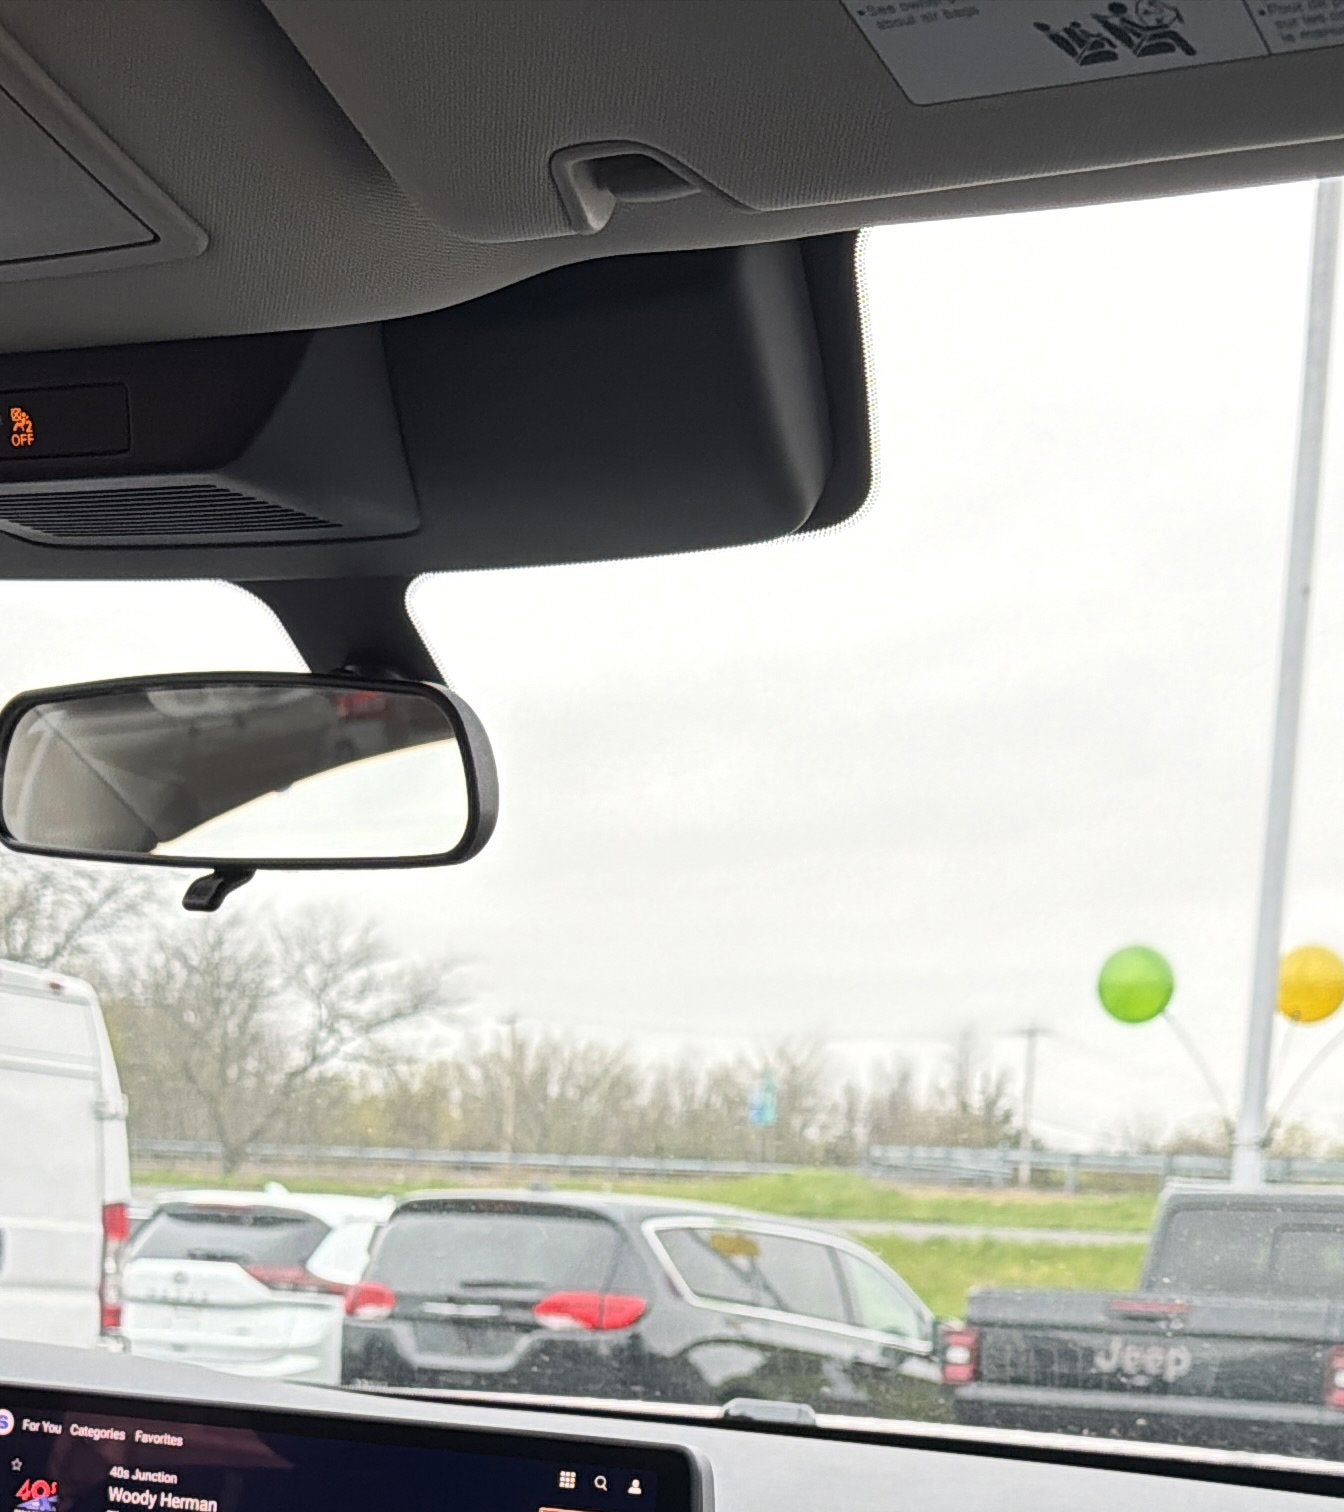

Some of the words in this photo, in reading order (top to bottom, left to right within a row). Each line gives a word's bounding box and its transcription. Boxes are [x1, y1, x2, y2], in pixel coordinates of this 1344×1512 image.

[11, 434, 34, 446] OFF
[1094, 1335, 1191, 1383] Jeep
[22, 1419, 40, 1432] For
[42, 1420, 62, 1435] You
[70, 1423, 126, 1442] Categories
[135, 1430, 183, 1447] Favorites
[110, 1465, 129, 1481] 40s
[131, 1469, 178, 1485] Junction
[108, 1486, 157, 1509] Woody
[160, 1492, 217, 1512] Herman
